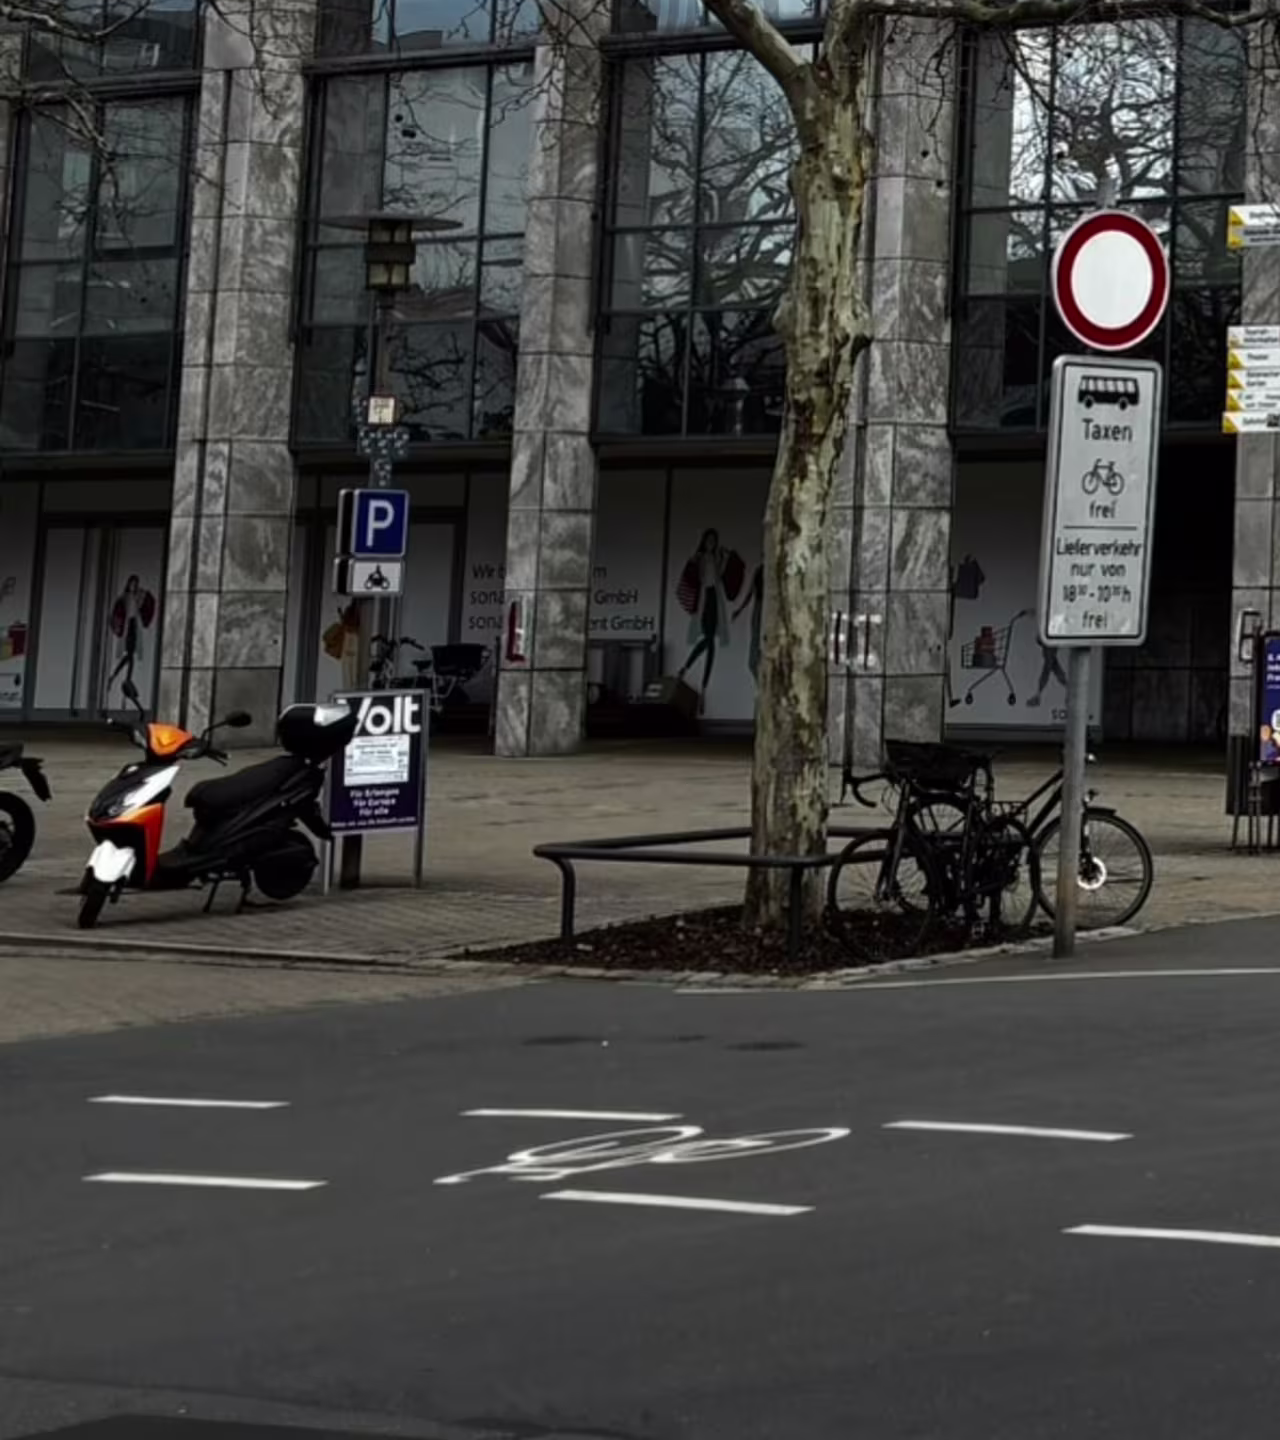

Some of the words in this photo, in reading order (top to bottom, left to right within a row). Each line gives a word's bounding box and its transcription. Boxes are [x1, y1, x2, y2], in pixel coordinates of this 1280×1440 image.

[1082, 418, 1132, 442] Taxen
[1089, 501, 1118, 519] frei
[366, 499, 395, 547] P
[1057, 537, 1142, 557] Lieferverkehr
[1070, 563, 1094, 577] nur
[1100, 563, 1126, 577] von
[470, 590, 504, 604] sona
[594, 589, 638, 604] GmbH
[611, 616, 654, 630] GmbH
[1083, 611, 1107, 629] frei
